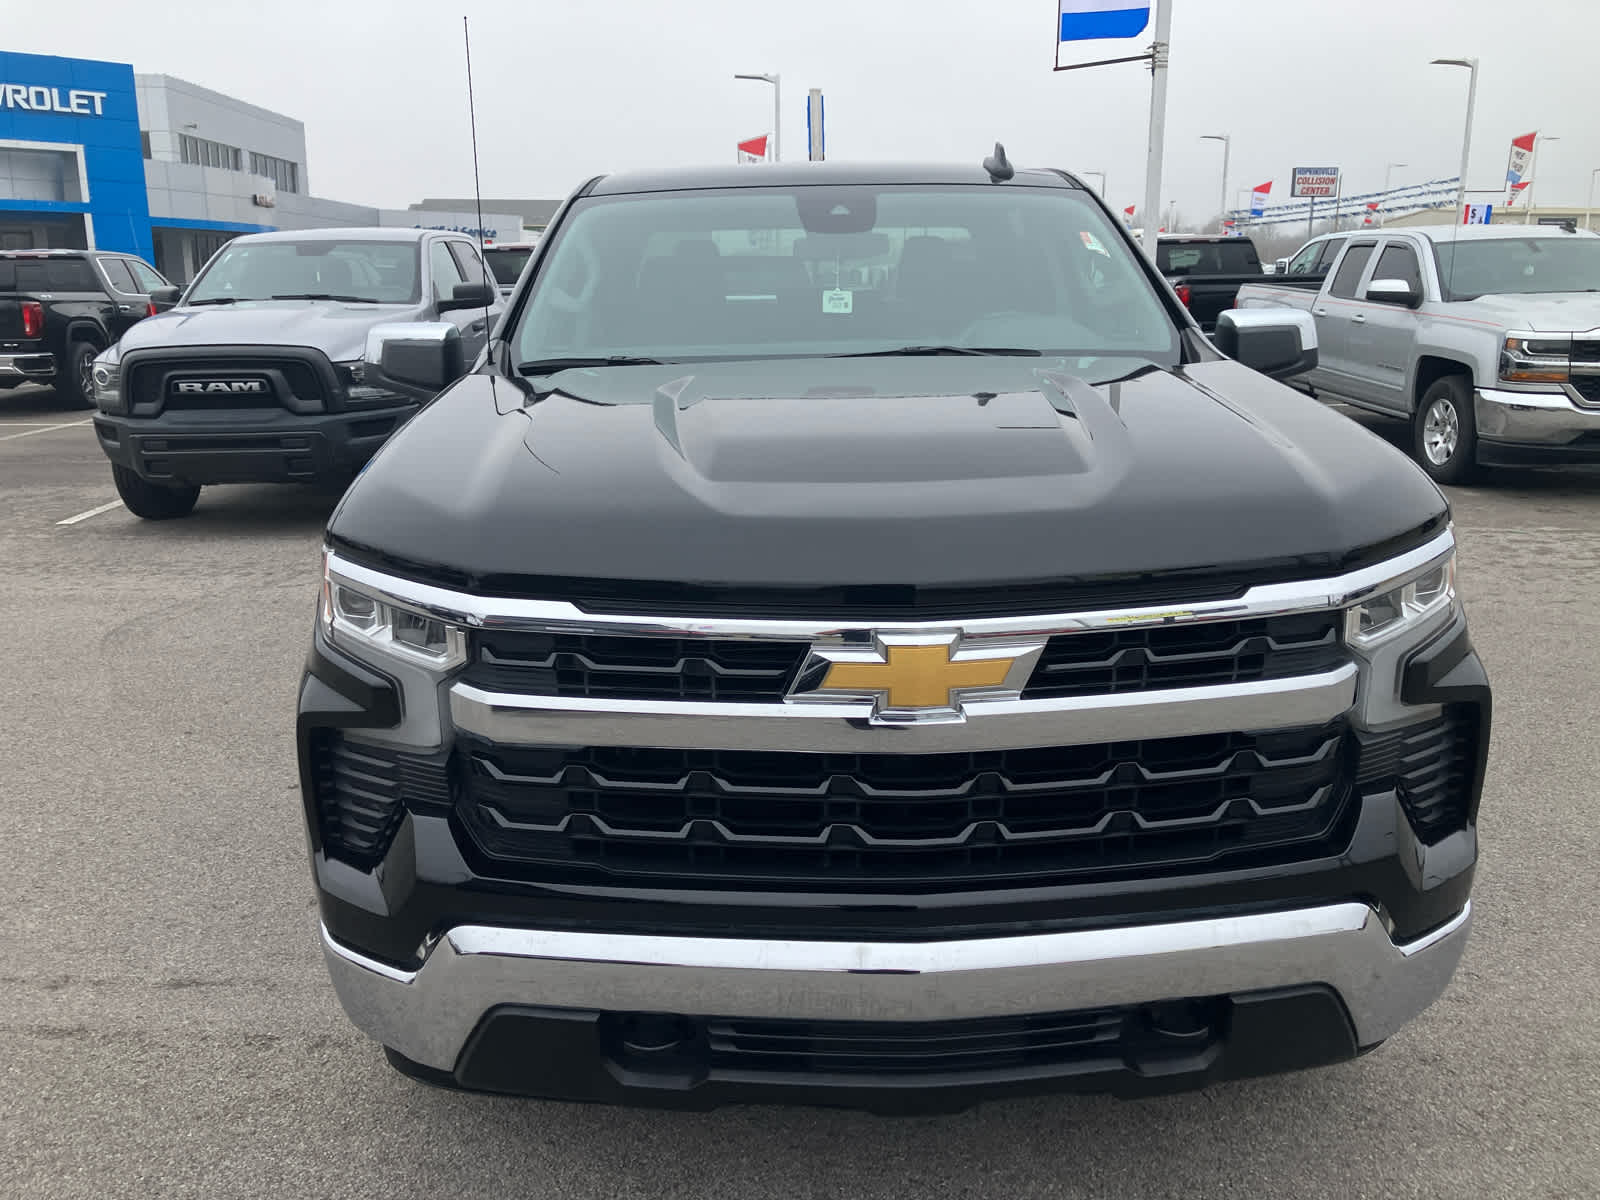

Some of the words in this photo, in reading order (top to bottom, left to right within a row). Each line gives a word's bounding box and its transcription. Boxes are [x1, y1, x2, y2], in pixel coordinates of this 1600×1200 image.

[0, 83, 107, 115] ROLET
[1296, 176, 1336, 185] COLLISION
[1300, 186, 1330, 195] CENTER
[178, 382, 260, 392] RAM
